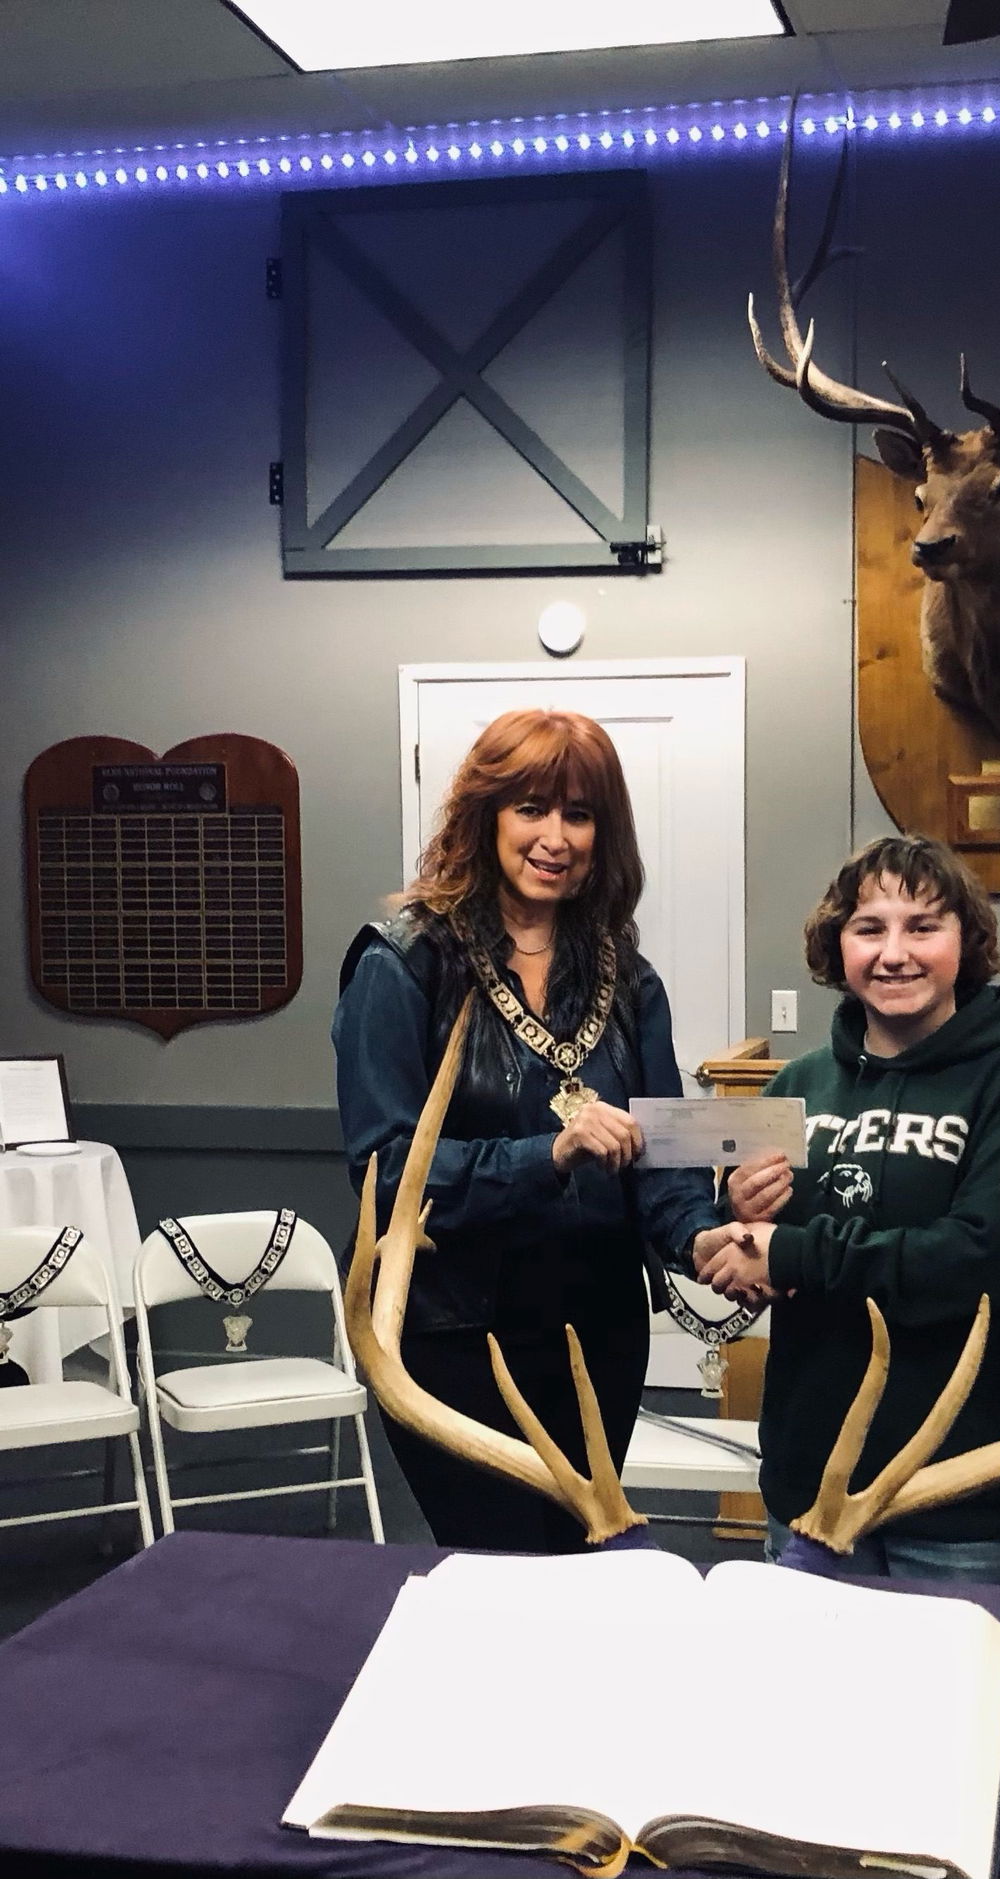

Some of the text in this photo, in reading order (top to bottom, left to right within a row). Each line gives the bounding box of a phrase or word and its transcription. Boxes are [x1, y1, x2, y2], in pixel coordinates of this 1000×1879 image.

[123, 768, 161, 776] NATIONAL
[165, 767, 217, 776] FOUNDATION
[133, 783, 184, 791] HONOR ROLL
